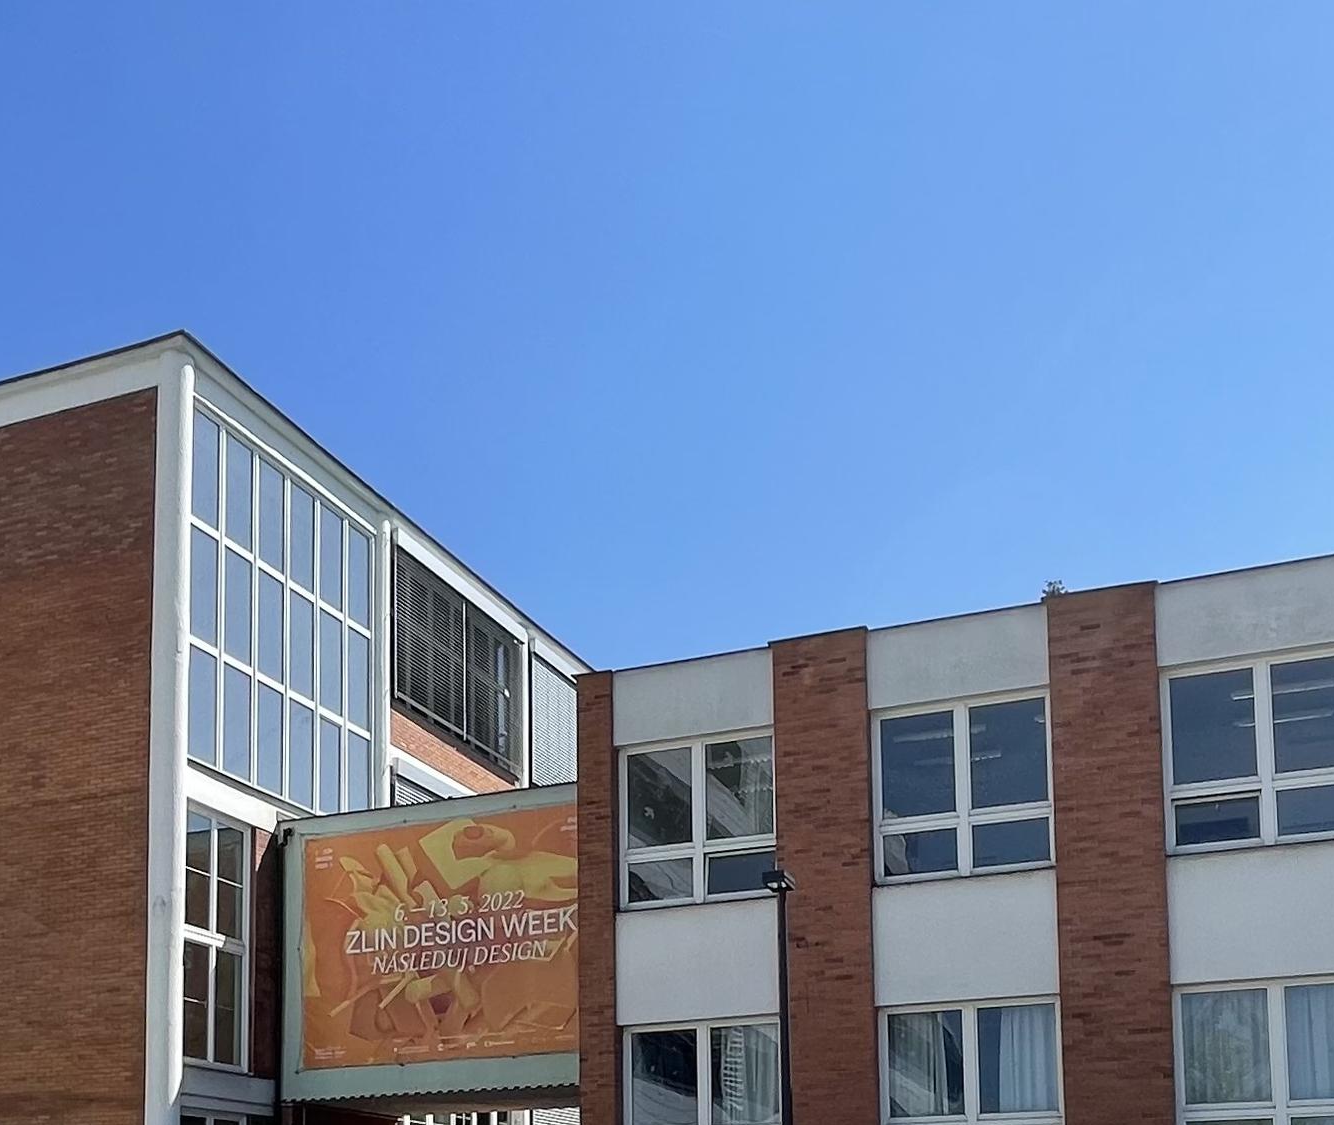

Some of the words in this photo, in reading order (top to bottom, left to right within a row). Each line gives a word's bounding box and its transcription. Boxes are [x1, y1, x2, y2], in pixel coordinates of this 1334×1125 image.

[457, 896, 472, 914] 5.
[478, 890, 525, 912] 2022
[346, 930, 397, 954] ZLIN
[403, 917, 494, 948] DESIGN
[501, 903, 578, 938] WEEK
[473, 940, 548, 965] DESIGN
